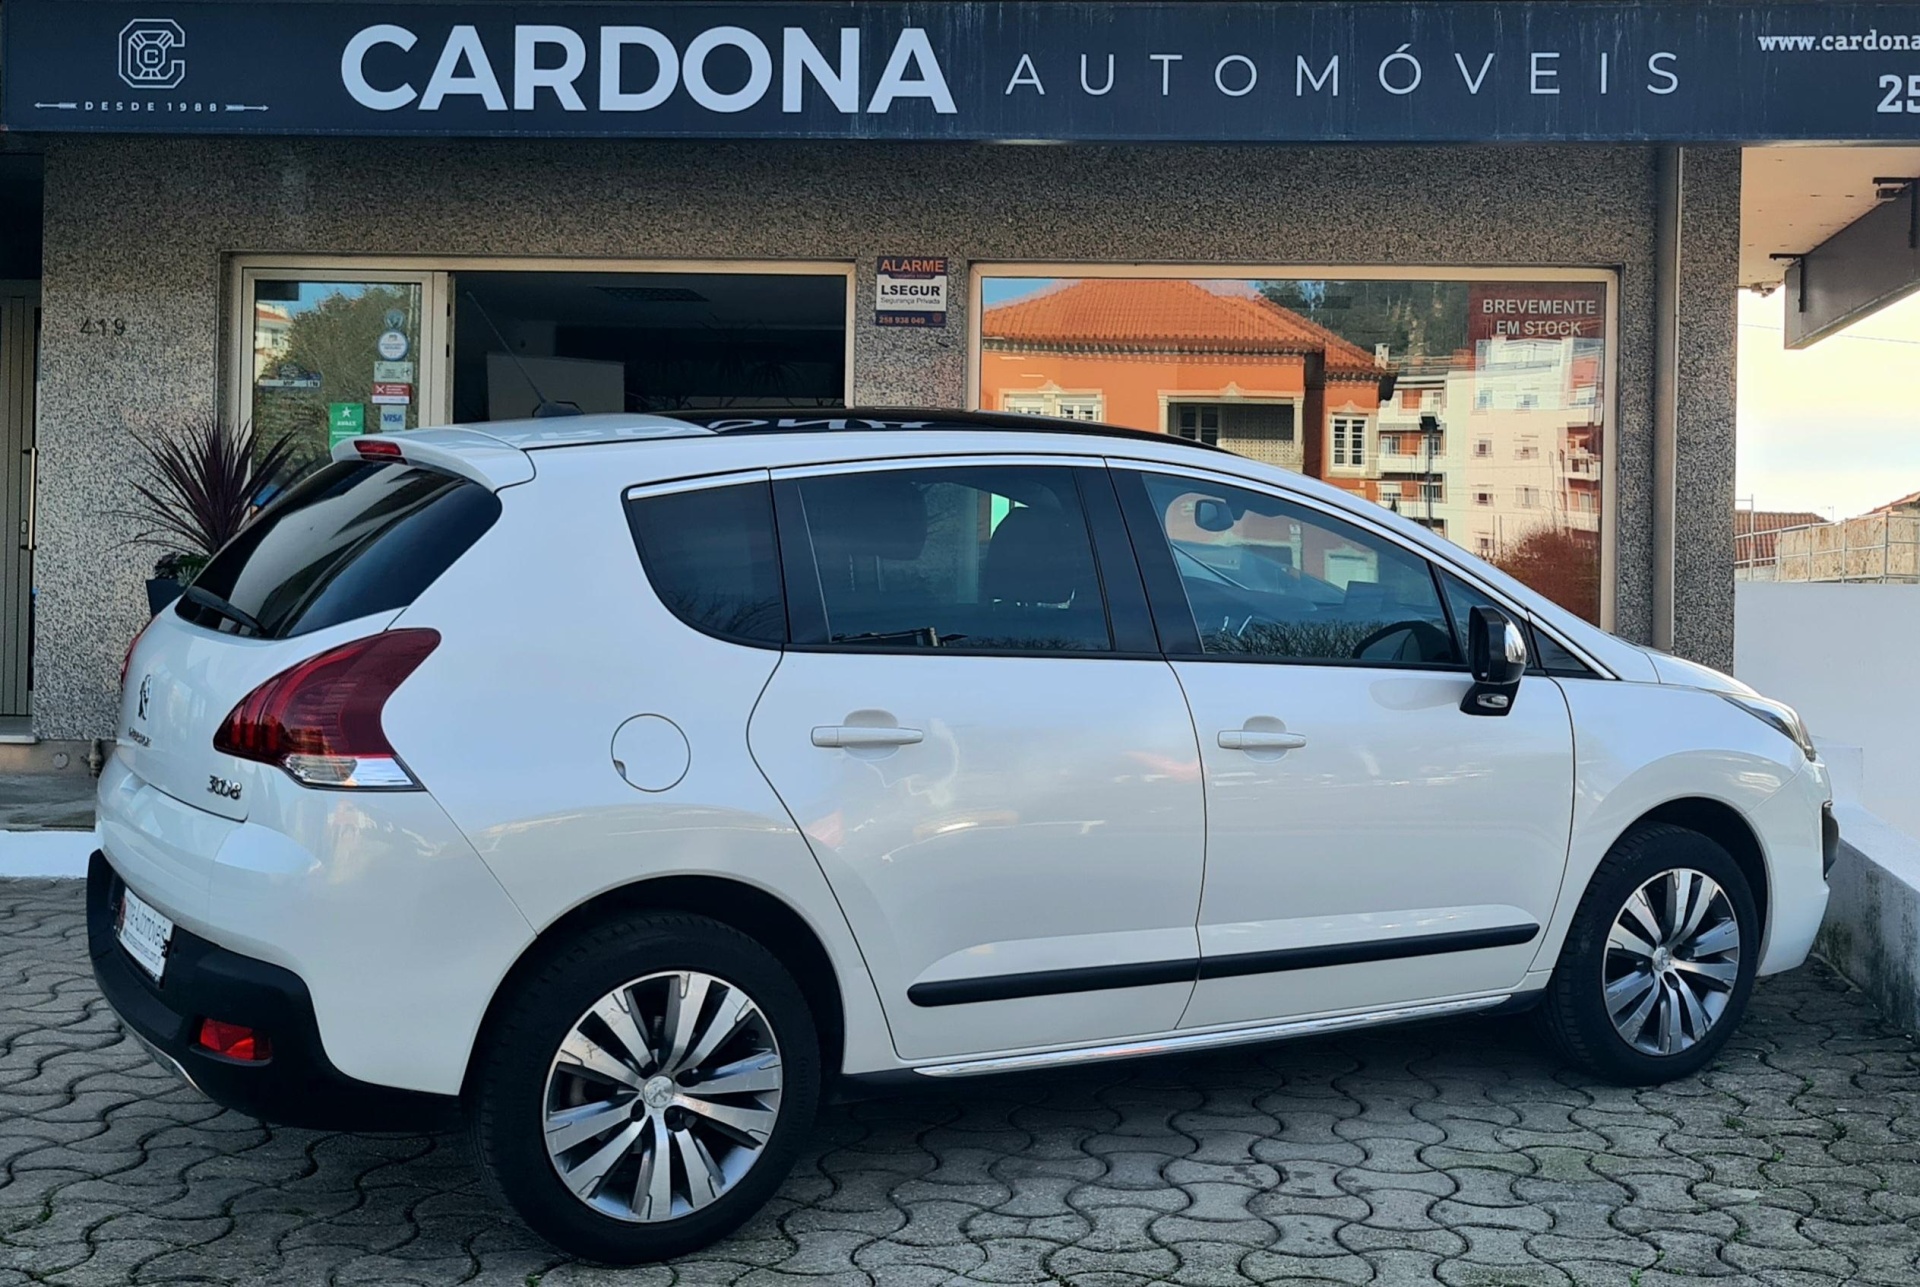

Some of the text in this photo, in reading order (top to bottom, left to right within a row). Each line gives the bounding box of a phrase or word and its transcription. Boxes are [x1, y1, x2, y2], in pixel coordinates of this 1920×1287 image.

[1757, 29, 1920, 51] www.cardona
[341, 23, 1679, 114] CARDONA AUTOMÓVEIS
[84, 101, 217, 113] DESDE 1988
[880, 259, 944, 272] ALARME
[881, 285, 940, 296] LSEGUR
[1482, 299, 1596, 314] BREVEMENTE
[80, 318, 126, 336] 419
[1496, 320, 1582, 336] EM STOCK
[383, 414, 403, 422] VISA
[206, 774, 243, 801] 3008
